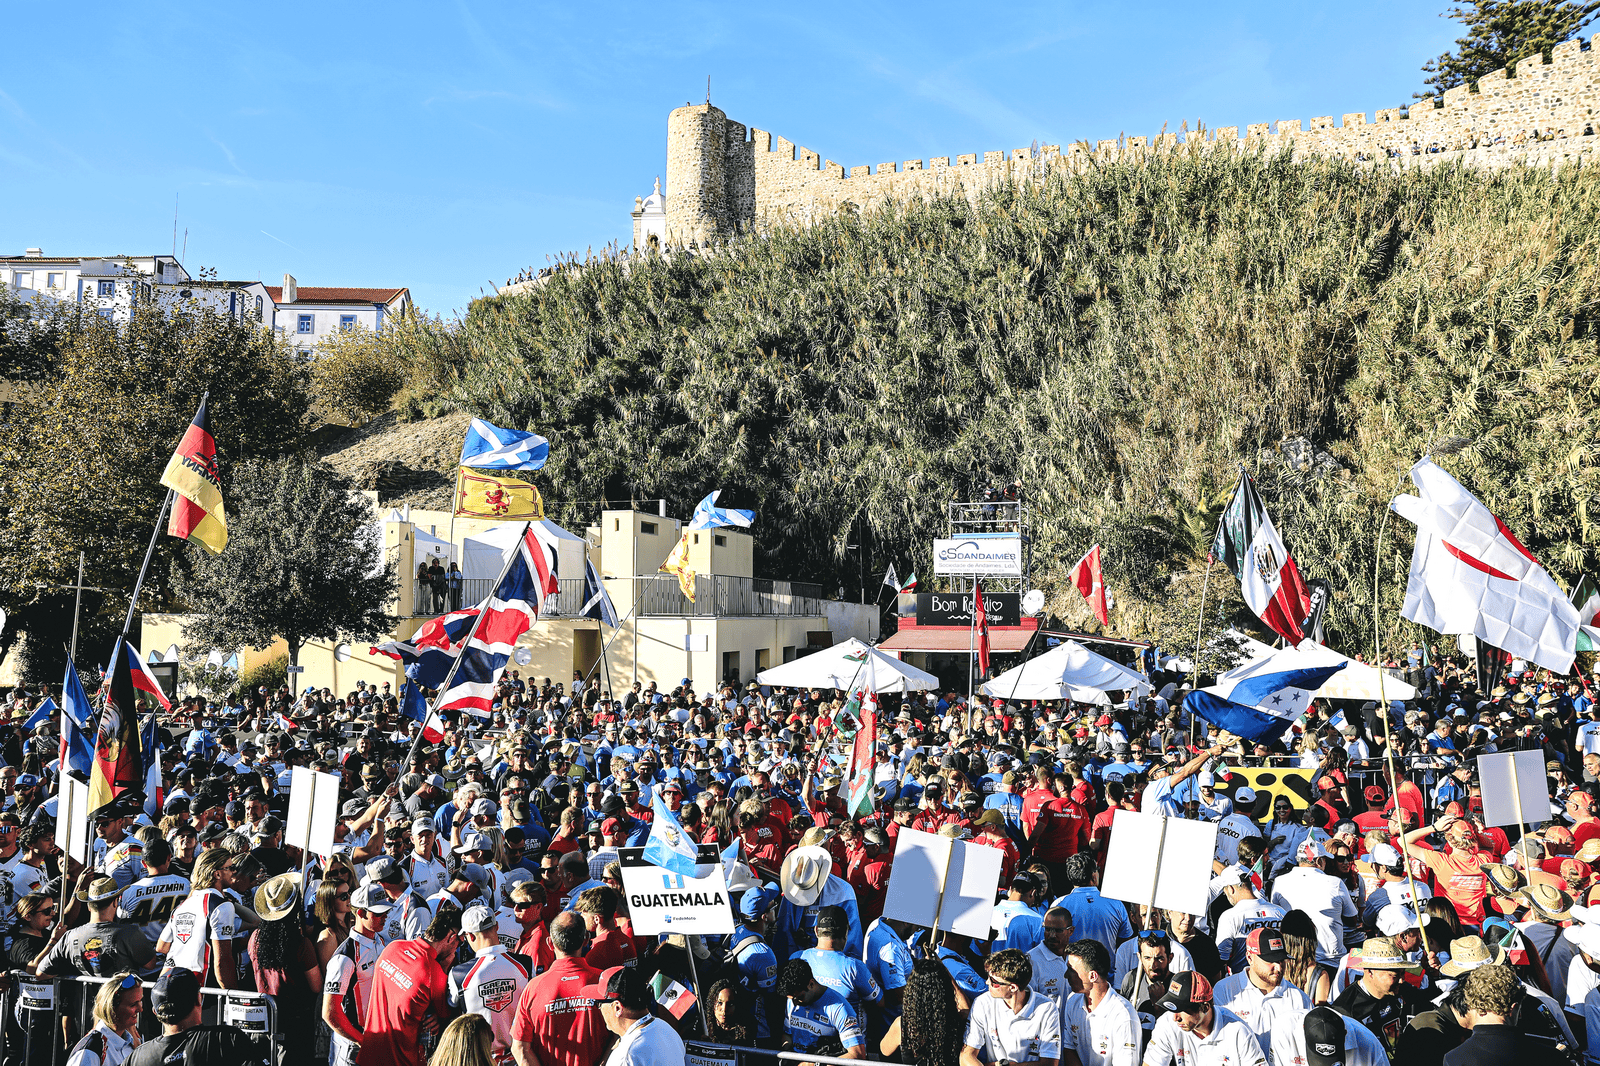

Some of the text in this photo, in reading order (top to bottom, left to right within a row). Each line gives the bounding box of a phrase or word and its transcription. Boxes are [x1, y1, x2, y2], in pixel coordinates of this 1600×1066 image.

[931, 595, 957, 612] Bom
[1219, 827, 1240, 839] MEXICO
[630, 892, 725, 908] GUATEMALA
[1245, 919, 1282, 934] MEXICO
[379, 959, 396, 976] TEAM
[393, 970, 414, 990] WALES
[815, 975, 842, 987] TORRE
[481, 984, 515, 996] BRITAIN
[483, 980, 511, 990] GREAT
[544, 1000, 567, 1013] TEAM
[568, 998, 596, 1008] WALES
[790, 1019, 822, 1035] GUATEMALA
[690, 1057, 729, 1066] GUATEMALA
